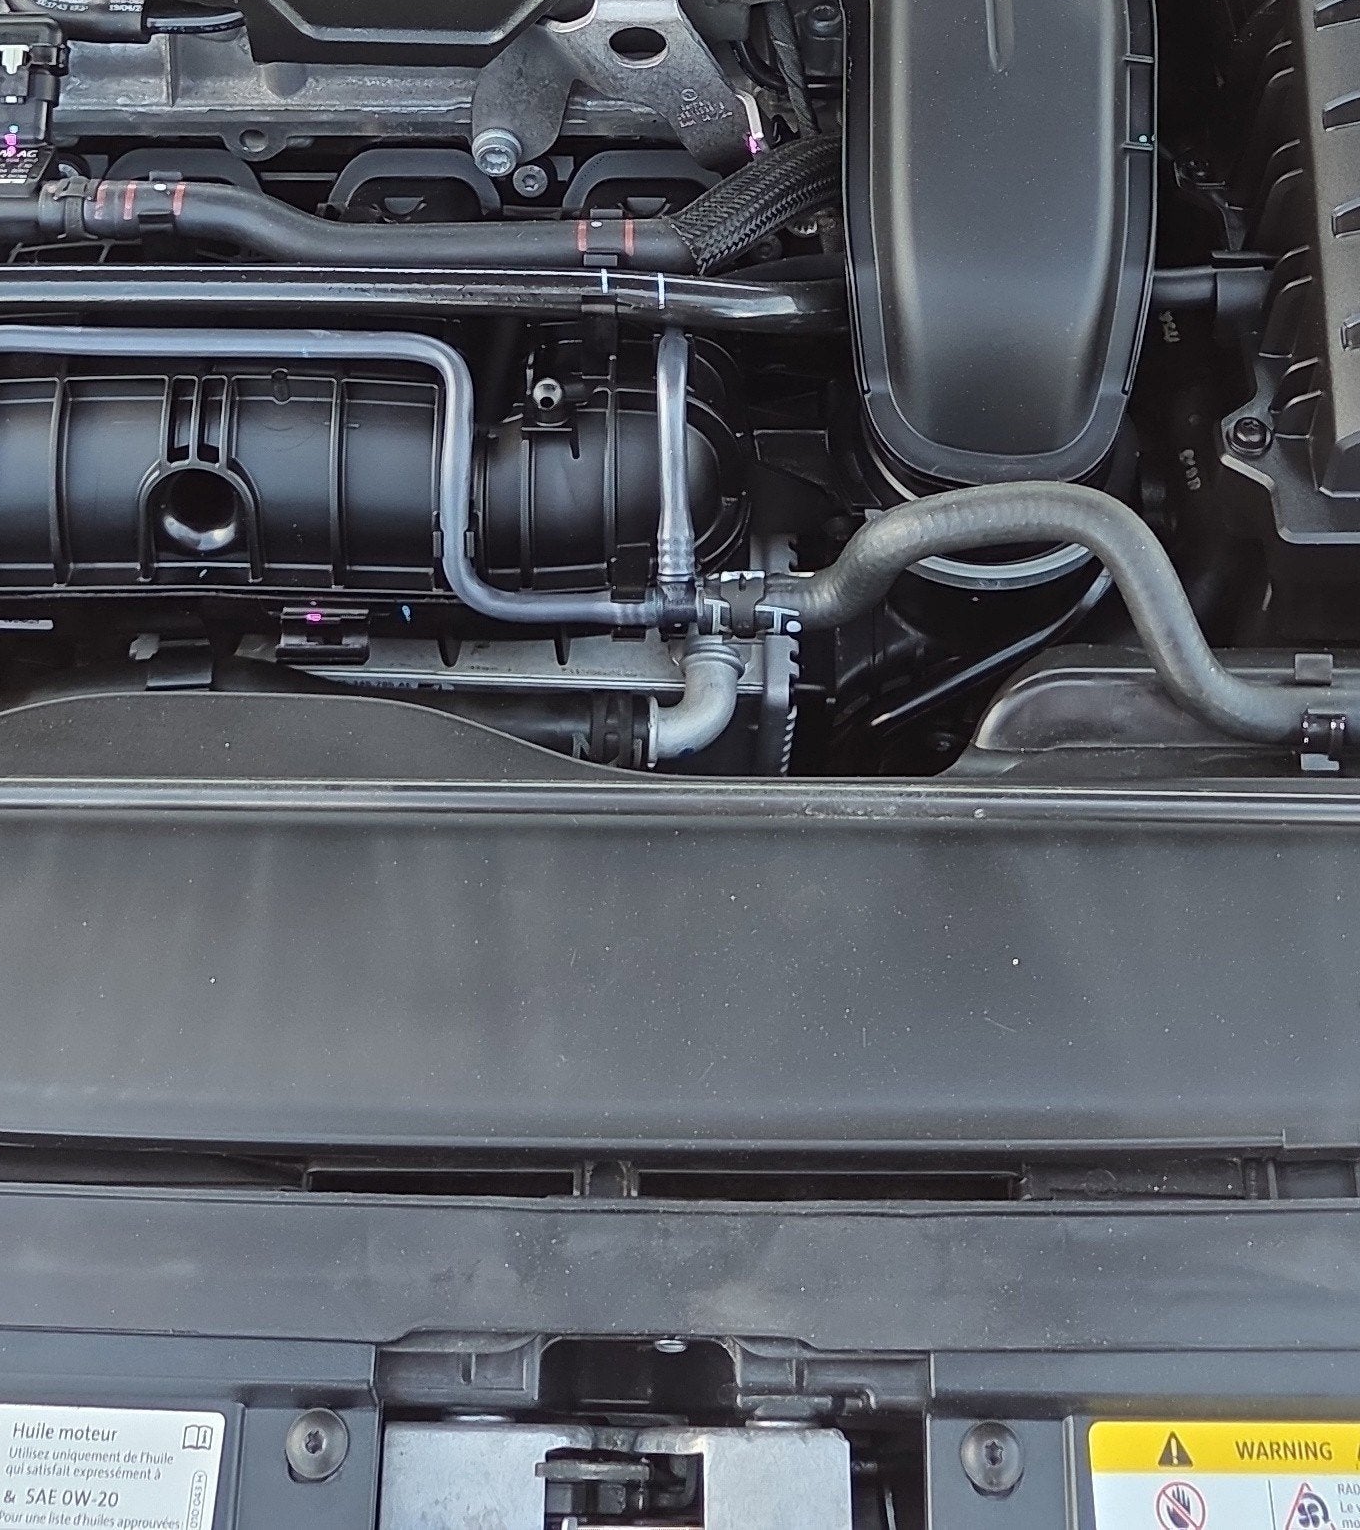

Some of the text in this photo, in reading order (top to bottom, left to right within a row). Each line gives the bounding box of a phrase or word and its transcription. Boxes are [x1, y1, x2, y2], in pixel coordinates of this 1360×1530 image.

[12, 1422, 119, 1442] Huile moteur
[9, 1446, 51, 1461] Utilisez
[52, 1449, 121, 1464] uniquement
[123, 1450, 138, 1464] de
[1236, 1440, 1333, 1461] WARNING
[5, 1462, 162, 1482] qui satisfait expressément à
[3, 1489, 17, 1504] &
[25, 1487, 58, 1506] SAE
[61, 1489, 120, 1508] 0W-20
[1340, 1502, 1354, 1515] Le
[25, 1513, 47, 1525] une
[48, 1512, 72, 1526] liste
[72, 1513, 116, 1528] d'huiles
